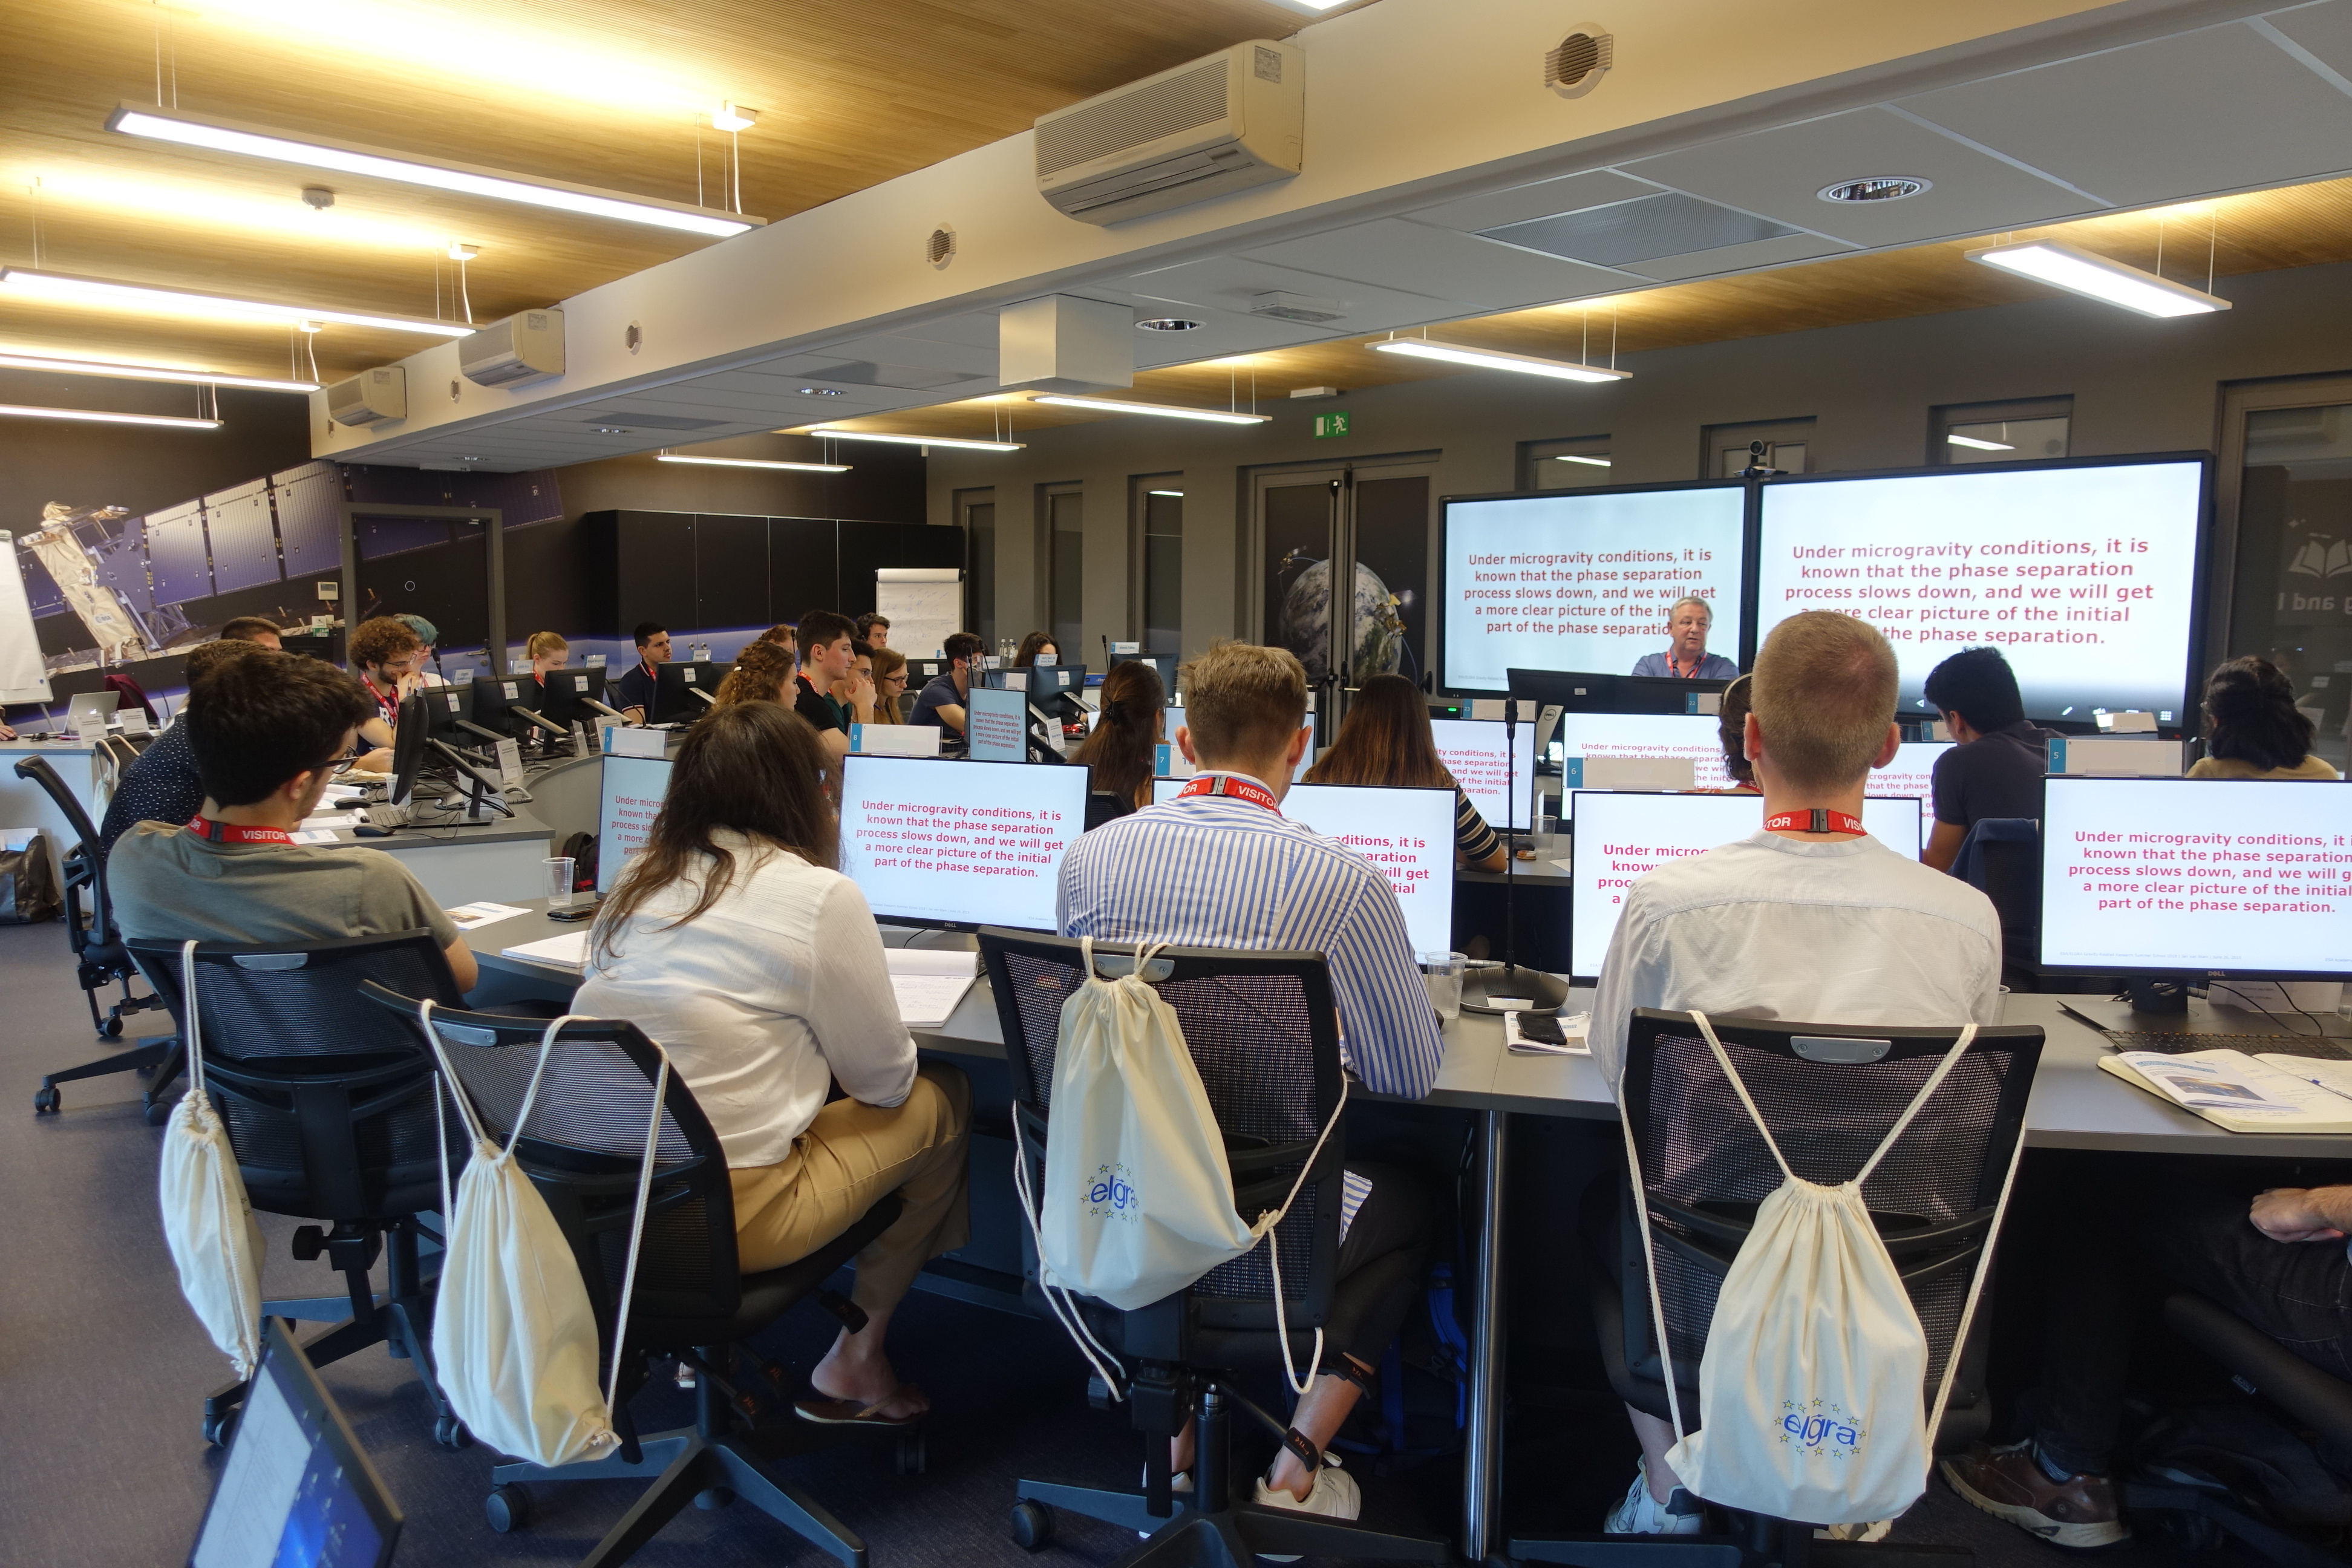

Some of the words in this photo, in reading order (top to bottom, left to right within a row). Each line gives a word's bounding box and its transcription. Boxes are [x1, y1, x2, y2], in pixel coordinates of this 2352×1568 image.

[1792, 545, 1844, 559] Under
[1851, 543, 1973, 561] microgravity
[1979, 540, 2097, 556] conditions,
[2106, 538, 2122, 554] it
[2129, 537, 2149, 554] is
[1469, 554, 1506, 566] Under
[1509, 552, 1593, 567] microgravity
[1597, 550, 1677, 563] conditions,
[1682, 549, 1694, 561] it
[1699, 549, 1712, 561] is
[1474, 571, 1517, 582] known
[1520, 570, 1547, 581] that
[1550, 570, 1573, 582] the
[1576, 569, 1618, 583] phase
[1622, 568, 1702, 583] separation
[1800, 566, 1860, 579] known
[1866, 564, 1904, 578] that
[1910, 564, 1942, 578] the
[1948, 563, 2009, 581] phase
[2015, 561, 2134, 580] separation
[1464, 589, 1512, 601] process
[1515, 587, 1552, 599] slows
[1555, 587, 1596, 600] down,
[1601, 587, 1628, 599] and
[1632, 589, 1655, 599] we
[1659, 586, 1686, 598] will
[1785, 588, 1853, 601] process
[1858, 585, 1912, 599] slows
[1916, 584, 1976, 601] down,
[1984, 584, 2023, 599] and
[2030, 587, 2062, 599] we
[2068, 583, 2108, 599] will
[2115, 584, 2154, 603] get
[1474, 606, 1483, 615] a
[1486, 606, 1518, 616] more
[1521, 605, 1554, 616] clear
[1557, 605, 1606, 618] picture
[1610, 604, 1625, 616] of
[1628, 604, 1653, 617] the
[1867, 605, 1913, 619] clear
[1919, 607, 1990, 622] picture
[1996, 606, 2018, 621] of
[2023, 606, 2059, 622] the
[2066, 606, 2130, 622] initial
[1486, 622, 1512, 634] part
[1515, 621, 1529, 633] of
[1532, 621, 1554, 633] the
[1557, 622, 1598, 636] phase
[1602, 622, 1670, 637] separatio
[1881, 626, 1913, 641] the
[1918, 627, 1978, 643] phase
[1984, 629, 2105, 645] separation.
[1612, 745, 1670, 754] microgravity
[2054, 751, 2059, 760] 5
[616, 795, 637, 805] Under
[619, 808, 643, 818] known
[861, 800, 895, 811] Under
[897, 802, 969, 818] microgravity
[971, 807, 1036, 821] conditions,
[1039, 809, 1049, 820] it
[1051, 810, 1062, 821] is
[612, 821, 640, 831] process
[866, 814, 904, 825] known
[906, 816, 930, 828] that
[932, 817, 952, 829] the
[953, 819, 988, 831] phase
[990, 823, 1054, 835] separation
[242, 829, 287, 841] VISITOR
[624, 835, 643, 843] more
[856, 829, 898, 839] process
[900, 830, 933, 842] slows
[935, 832, 970, 846] down,
[973, 835, 996, 846] and
[998, 838, 1016, 848] we
[1019, 838, 1041, 849] will
[1043, 840, 1065, 852] get
[1334, 834, 1393, 849] ditions,
[1399, 836, 1410, 848] it
[1413, 837, 1426, 848] is
[2074, 831, 2124, 843] Under
[2128, 832, 2232, 847] microgravity
[2236, 834, 2327, 848] conditions,
[2333, 835, 2345, 846] it
[874, 844, 904, 854] more
[906, 844, 935, 855] clear
[936, 846, 978, 859] picture
[979, 849, 993, 860] of
[995, 850, 1015, 861] the
[1017, 851, 1052, 864] initial
[1603, 844, 1651, 856] Under
[2083, 847, 2138, 859] known
[2141, 848, 2176, 860] that
[2180, 849, 2207, 861] the
[2212, 849, 2262, 863] phase
[2265, 851, 2352, 864] separation
[874, 857, 898, 867] part
[900, 858, 912, 868] of
[913, 858, 933, 870] the
[935, 861, 970, 873] phase
[972, 864, 1039, 878] separation.
[1405, 869, 1429, 881] get
[2068, 866, 2131, 877] process
[2135, 864, 2183, 877] slows
[2186, 865, 2236, 880] down,
[2241, 867, 2273, 878] and
[2278, 869, 2302, 879] we
[2307, 867, 2337, 879] will
[1598, 878, 1632, 890] proc
[2082, 882, 2093, 892] a
[2097, 883, 2140, 893] more
[2144, 881, 2185, 893] clear
[2189, 882, 2248, 896] picture
[2252, 883, 2270, 895] of
[2273, 884, 2301, 896] the
[2305, 884, 2352, 897] initial
[1612, 895, 1621, 904] a
[2098, 898, 2132, 911] part
[2136, 897, 2154, 909] of
[2157, 898, 2185, 910] the
[2189, 898, 2239, 913] phase
[2243, 901, 2336, 914] separation.
[1783, 1414, 1857, 1447] elgra
